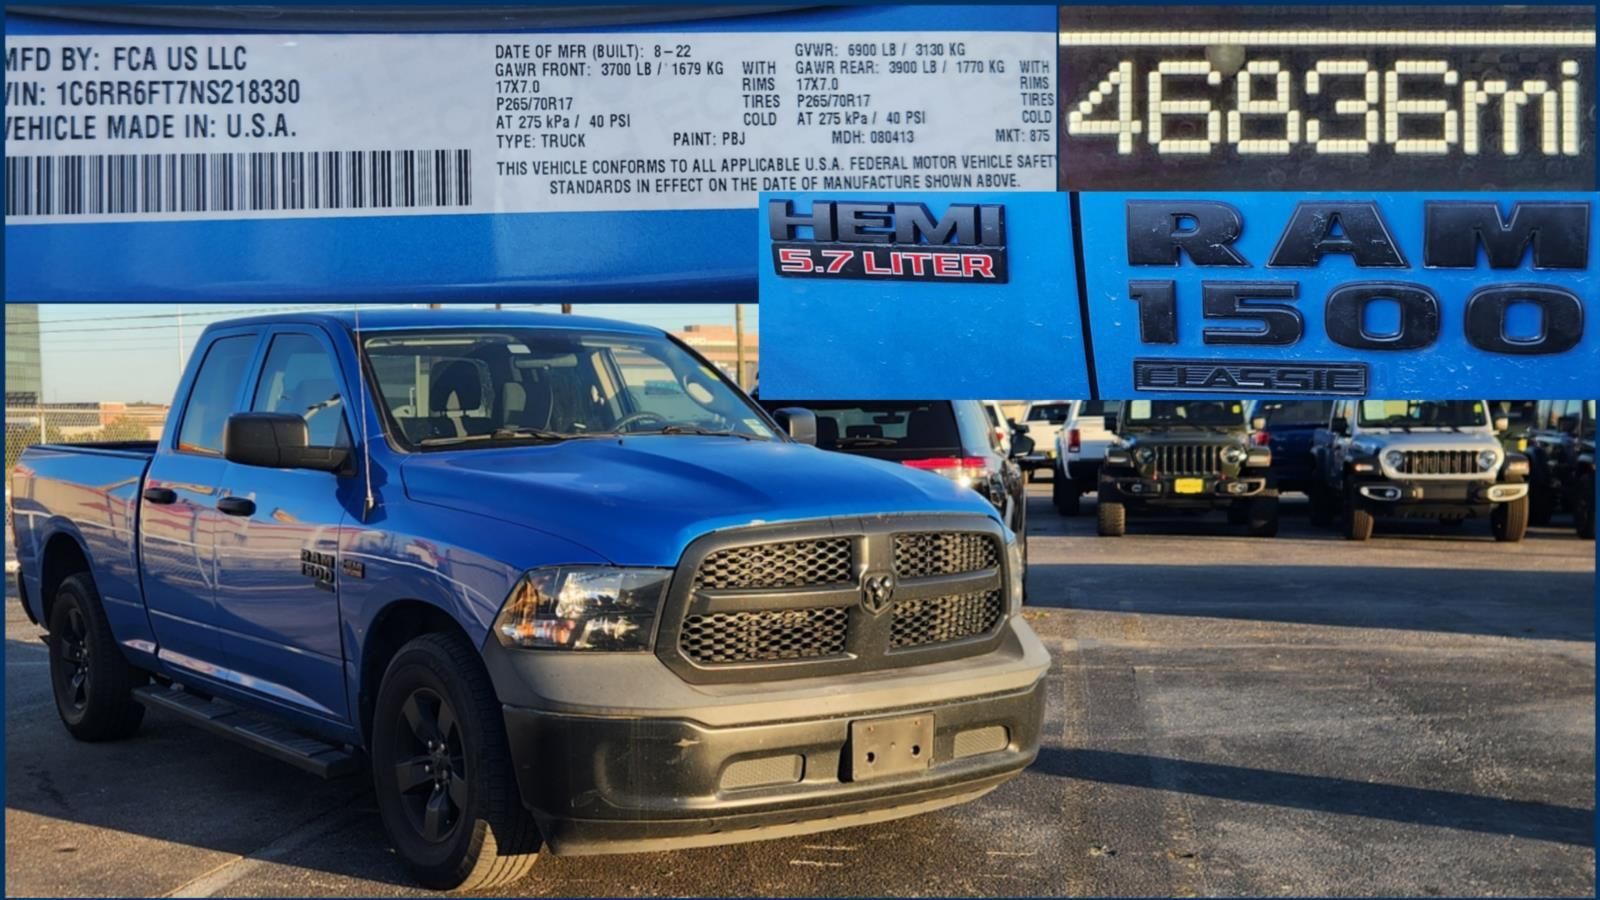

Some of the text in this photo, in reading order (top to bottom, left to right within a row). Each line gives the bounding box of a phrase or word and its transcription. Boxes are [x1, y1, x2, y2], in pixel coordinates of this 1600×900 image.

[495, 44, 530, 59] DATE
[535, 44, 552, 58] OF
[558, 44, 587, 58] MFR
[592, 44, 644, 61] (BUILT):
[794, 43, 966, 57] GVWR: 6900 LB / 3130 KG
[62, 46, 99, 71] BY:
[114, 46, 157, 71] FCA
[167, 46, 198, 71] US
[208, 45, 247, 71] LLC
[495, 61, 724, 77] GAWR FRONT: 3700 LB / 1679 KG
[742, 61, 776, 75] WITH
[795, 60, 1005, 74] GAWR REAR: 3900 LB / 1770 KG
[1019, 60, 1050, 73] WITH
[496, 80, 540, 93] 17X7.0
[742, 77, 775, 91] RIMS
[796, 77, 838, 90] 17X7.0
[1020, 76, 1049, 89] RIMS
[57, 79, 300, 106] 1C6RR6FT7NS218330
[1020, 92, 1055, 106] TIRES
[496, 97, 573, 111] P265/70R17
[742, 94, 780, 108] TIRES
[797, 94, 871, 108] P265/70R17
[496, 113, 631, 129] AT 275 kPa / 40 PSI
[743, 112, 777, 126] COLD
[797, 111, 926, 125] AT 275 kPa / 40 PSI
[1022, 110, 1052, 123] COLD
[107, 114, 174, 139] MADE
[185, 114, 215, 138] IN:
[227, 113, 296, 138] U.S.A.
[496, 133, 586, 149] TYPE: TRUCK
[673, 131, 746, 146] PAINT: PBJ
[831, 130, 915, 144] MDH: 080413
[995, 128, 1050, 142] MKT: 875
[496, 154, 1057, 176] THIS VEHICLE CONFORMS TO ALL APPLICABLE U.S.A. FEDERAL MOTOR VEHICLE SAFET
[550, 173, 1021, 194] STANDARDS IN EFFECT ON THE DATE OF MANUFACTURE SHOWN ABOVE.
[769, 199, 1006, 247] HEMI
[1127, 199, 1590, 270] RAM
[778, 248, 995, 279] 5.7 LITER
[1128, 279, 1585, 356] 1500
[1138, 364, 1364, 393] CLASSIC
[301, 548, 336, 569] RAM
